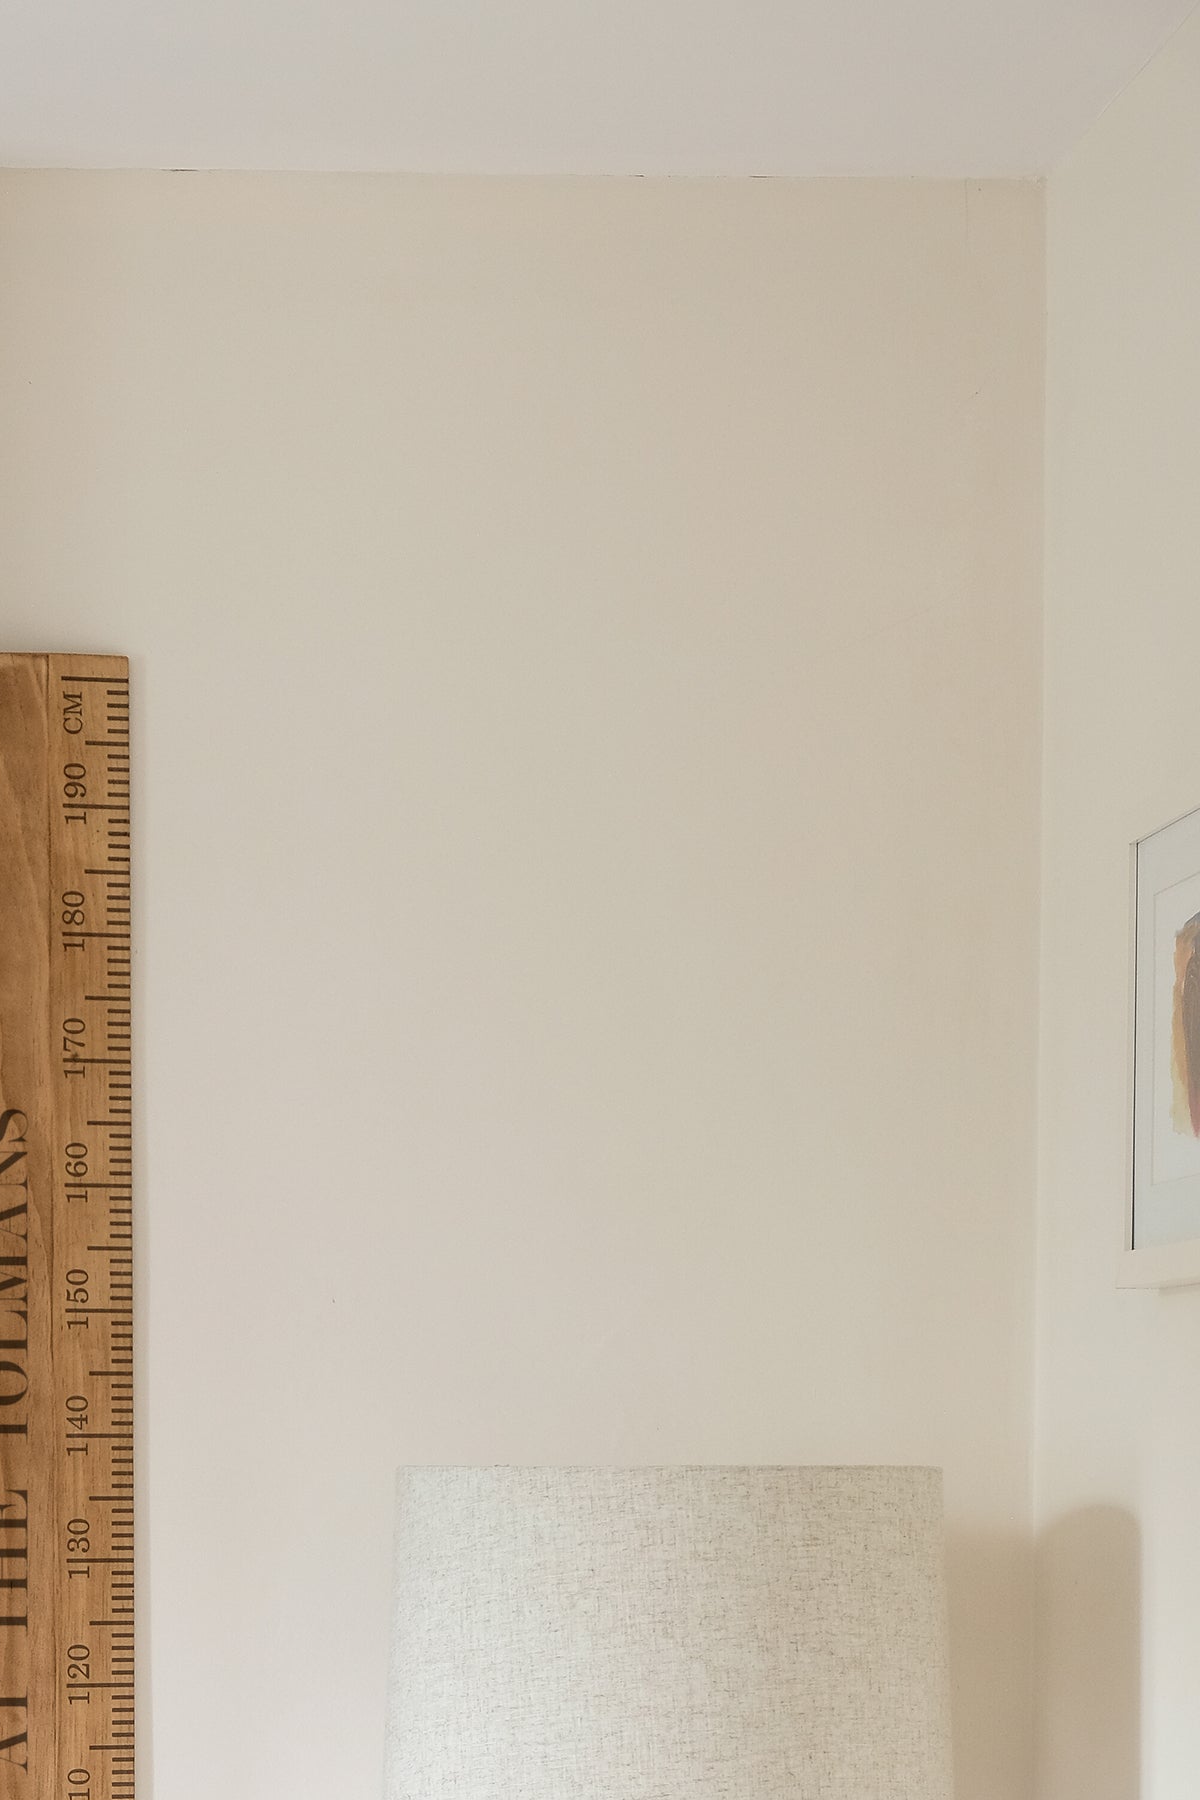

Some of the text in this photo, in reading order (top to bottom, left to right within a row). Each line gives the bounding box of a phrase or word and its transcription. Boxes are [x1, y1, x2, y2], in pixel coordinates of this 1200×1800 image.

[63, 691, 82, 734] CM
[64, 763, 86, 824] 190
[62, 890, 85, 952] 180
[63, 1017, 86, 1078] 170
[66, 1142, 88, 1203] 160
[66, 1269, 89, 1330] 150
[66, 1395, 88, 1456] 140
[67, 1518, 89, 1579] 130
[67, 1644, 89, 1705] 120
